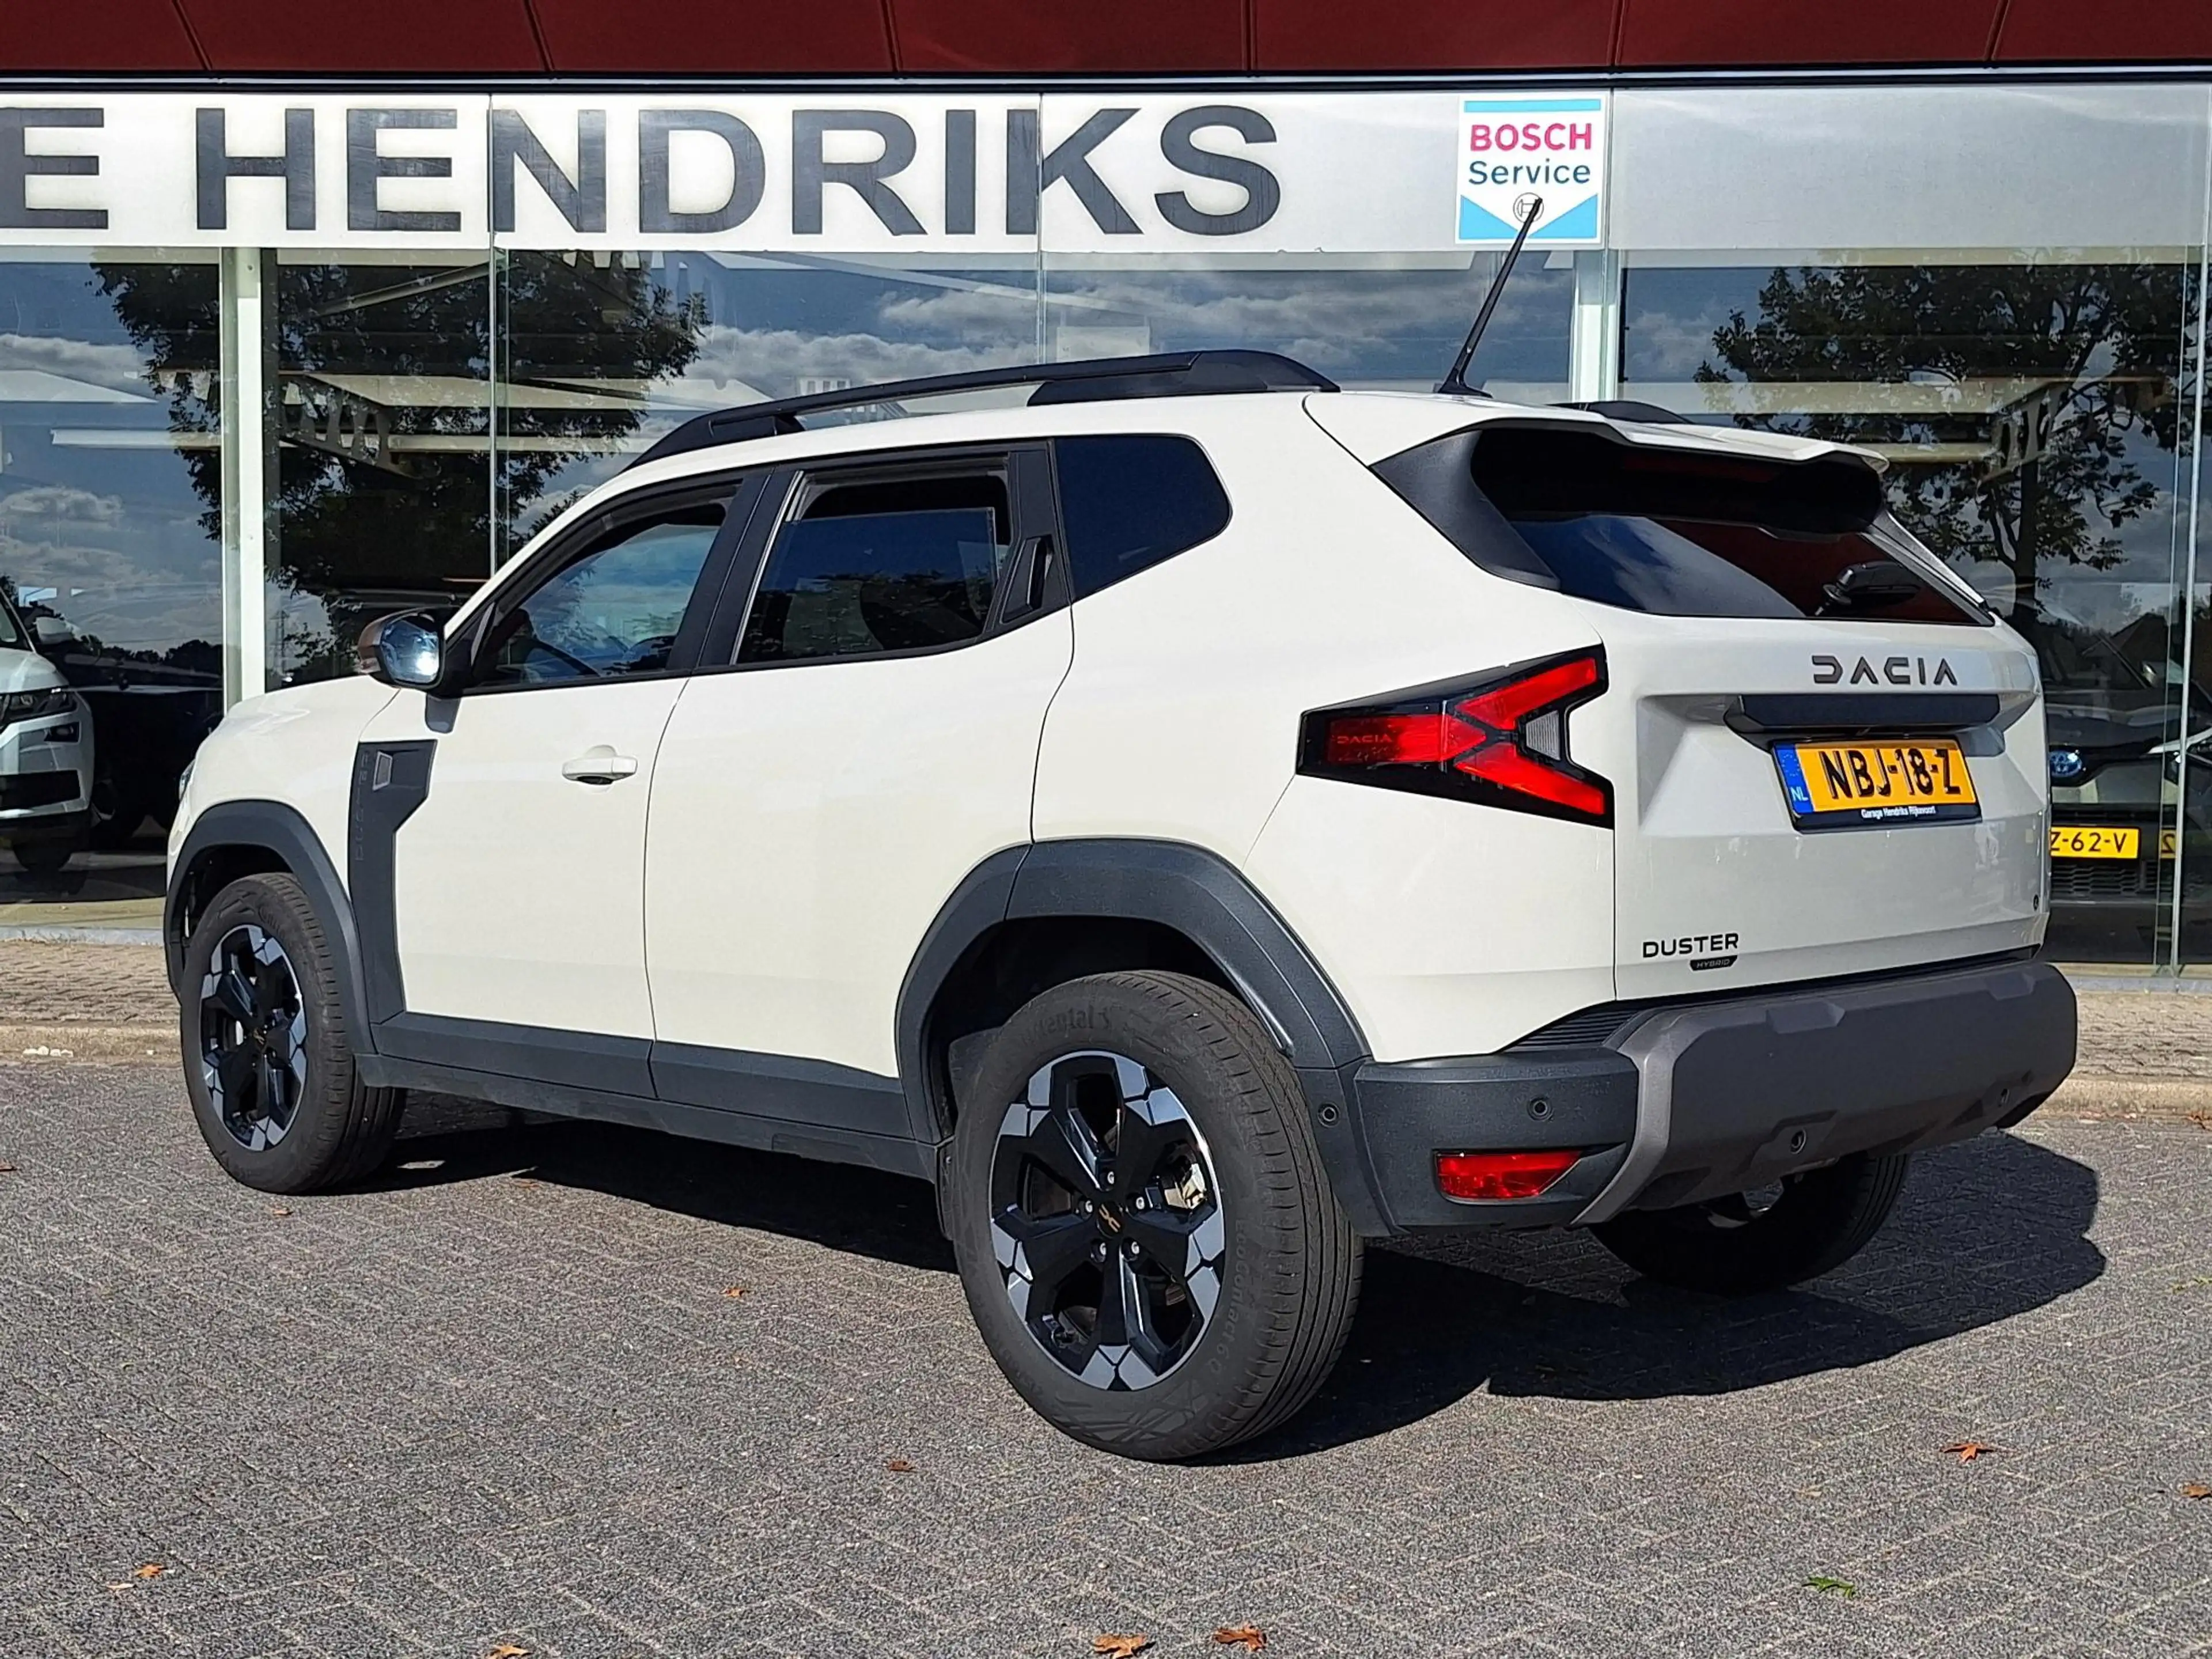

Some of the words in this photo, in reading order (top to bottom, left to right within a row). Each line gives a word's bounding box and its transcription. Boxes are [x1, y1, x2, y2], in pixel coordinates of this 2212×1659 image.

[1470, 123, 1592, 151] BOSCH
[0, 107, 109, 229] E
[196, 105, 1281, 236] HENDRIKS
[1468, 157, 1590, 185] Service
[1811, 655, 1959, 686] DACIA
[1336, 734, 1393, 744] DACIA
[1819, 748, 1961, 800] NBJ-18-Z
[1790, 785, 1810, 802] NL
[1643, 933, 1739, 959] DUSTER
[1696, 958, 1731, 969] HYBRID
